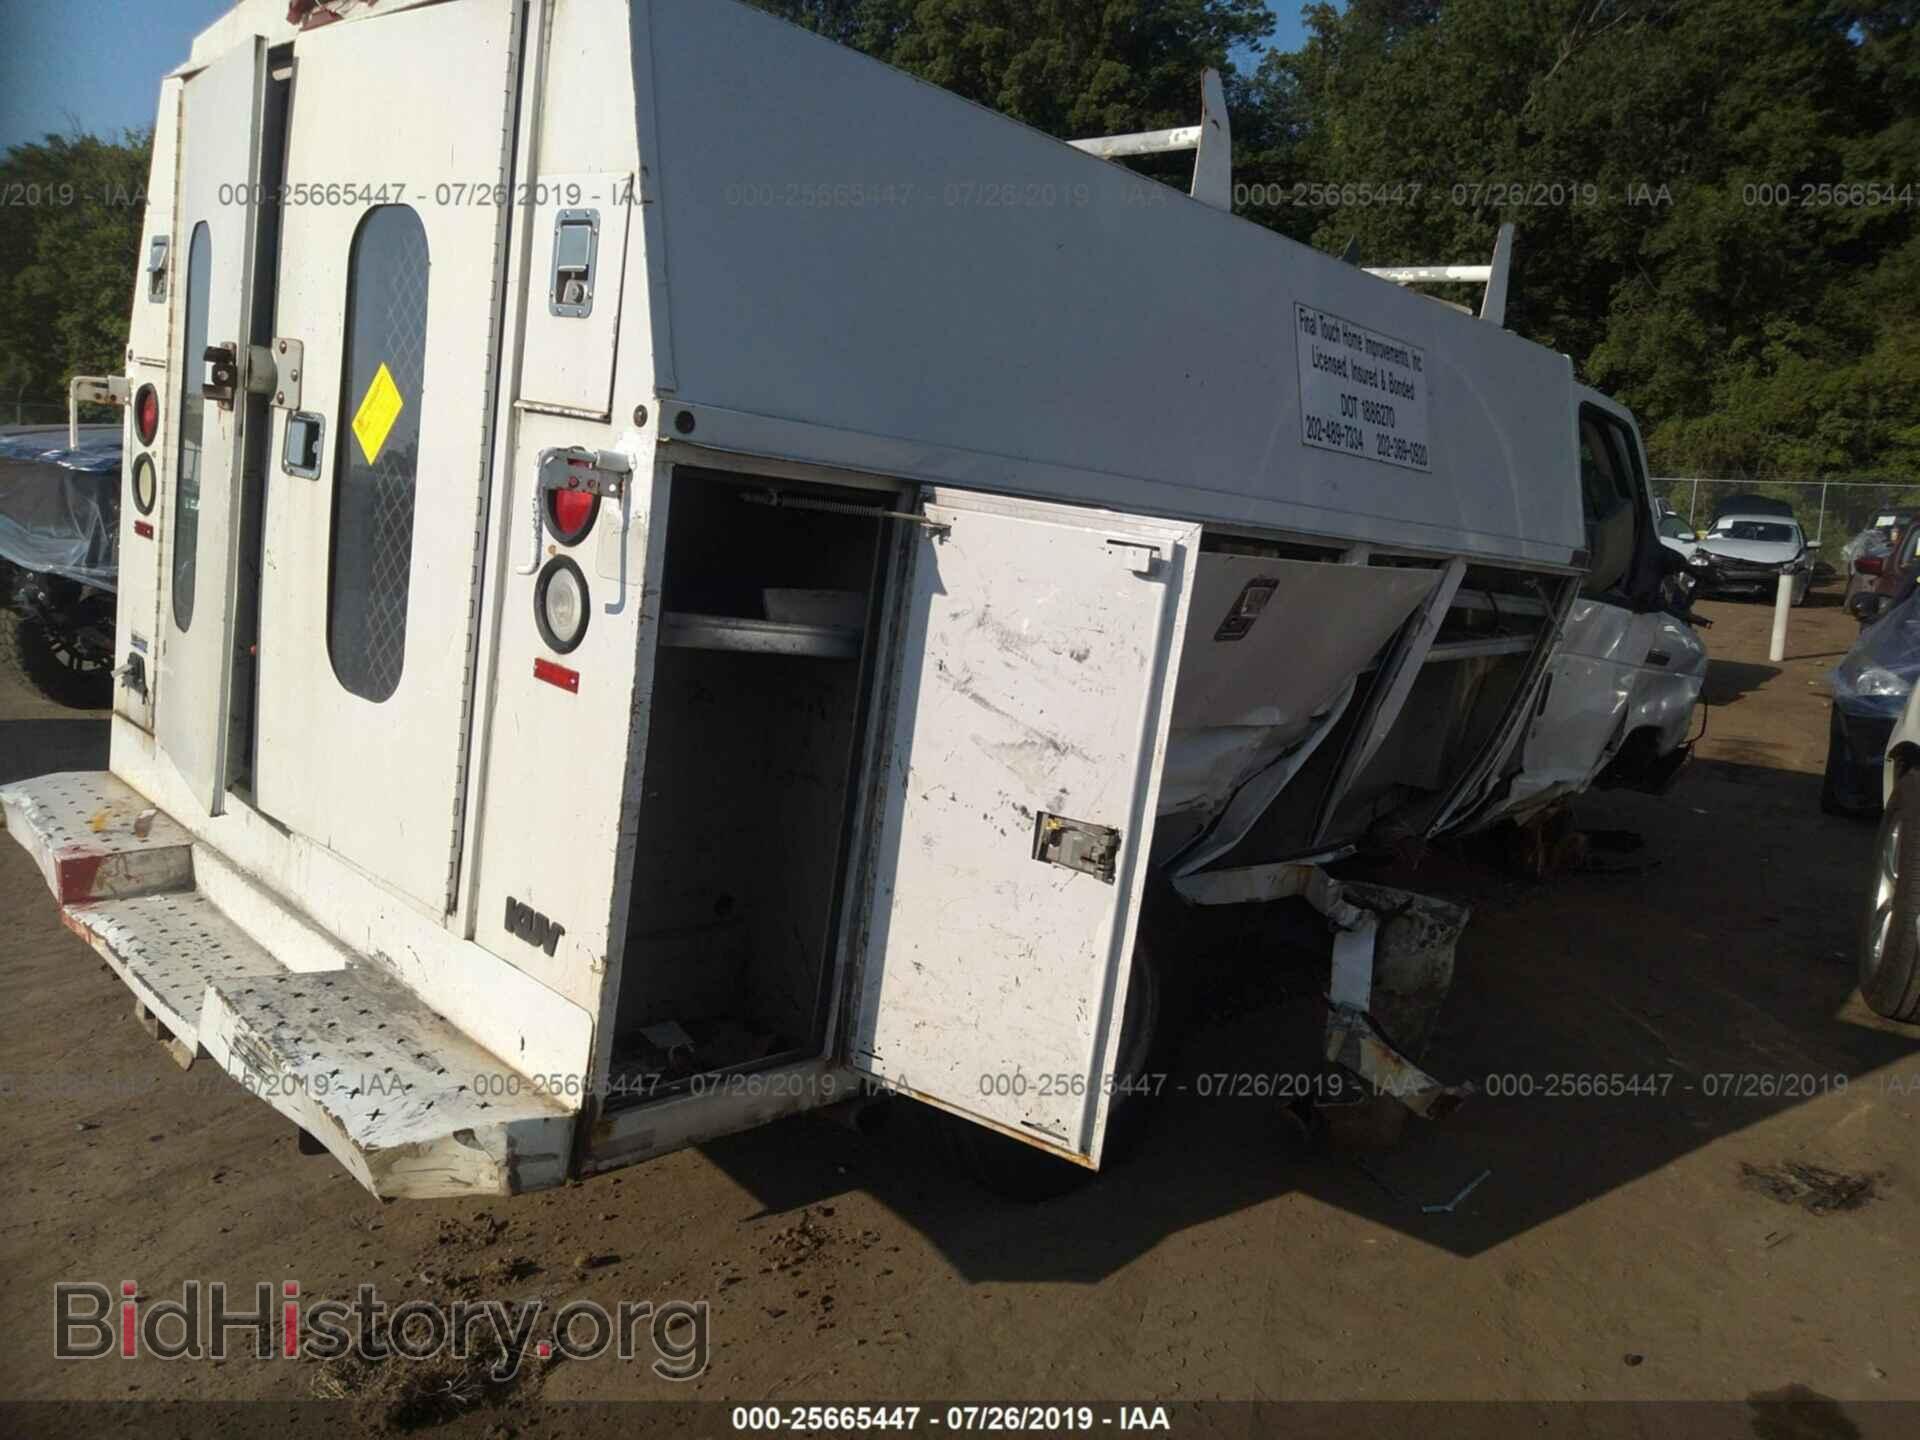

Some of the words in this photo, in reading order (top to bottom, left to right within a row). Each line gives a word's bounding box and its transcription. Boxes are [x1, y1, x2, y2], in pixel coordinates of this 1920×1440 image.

[1319, 314, 1340, 344] Touch
[1342, 322, 1363, 352] Home
[1350, 359, 1379, 389] Insured
[1388, 371, 1415, 401] Bonded
[1340, 393, 1359, 420] DOT
